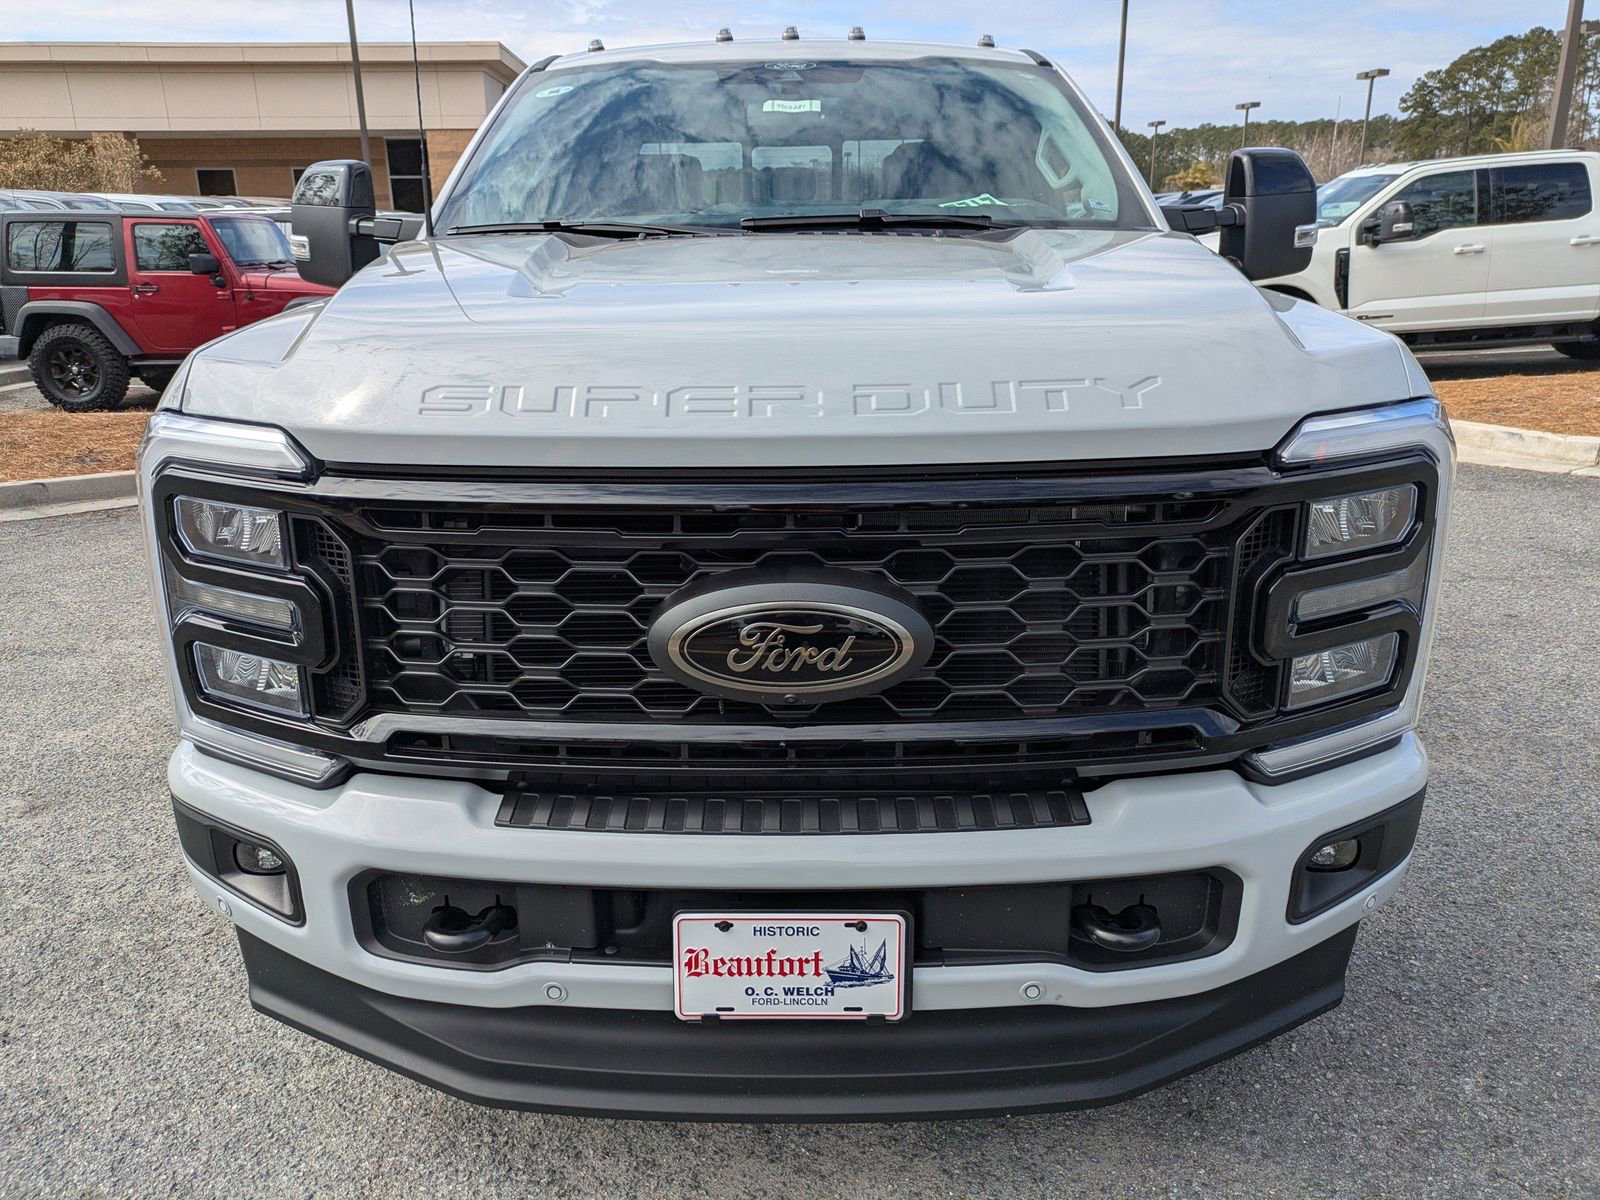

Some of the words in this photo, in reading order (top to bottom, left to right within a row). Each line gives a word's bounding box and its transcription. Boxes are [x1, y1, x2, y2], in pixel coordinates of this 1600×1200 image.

[418, 384, 824, 418] SUPER
[852, 376, 1162, 416] DUTY
[726, 621, 856, 673] Ford
[752, 925, 821, 937] HISTORIC
[683, 947, 825, 978] Beaufort
[744, 986, 760, 997] O.
[764, 986, 778, 997] C.
[783, 986, 835, 997] WELCH
[751, 997, 828, 1006] FORD-LINCOLN
